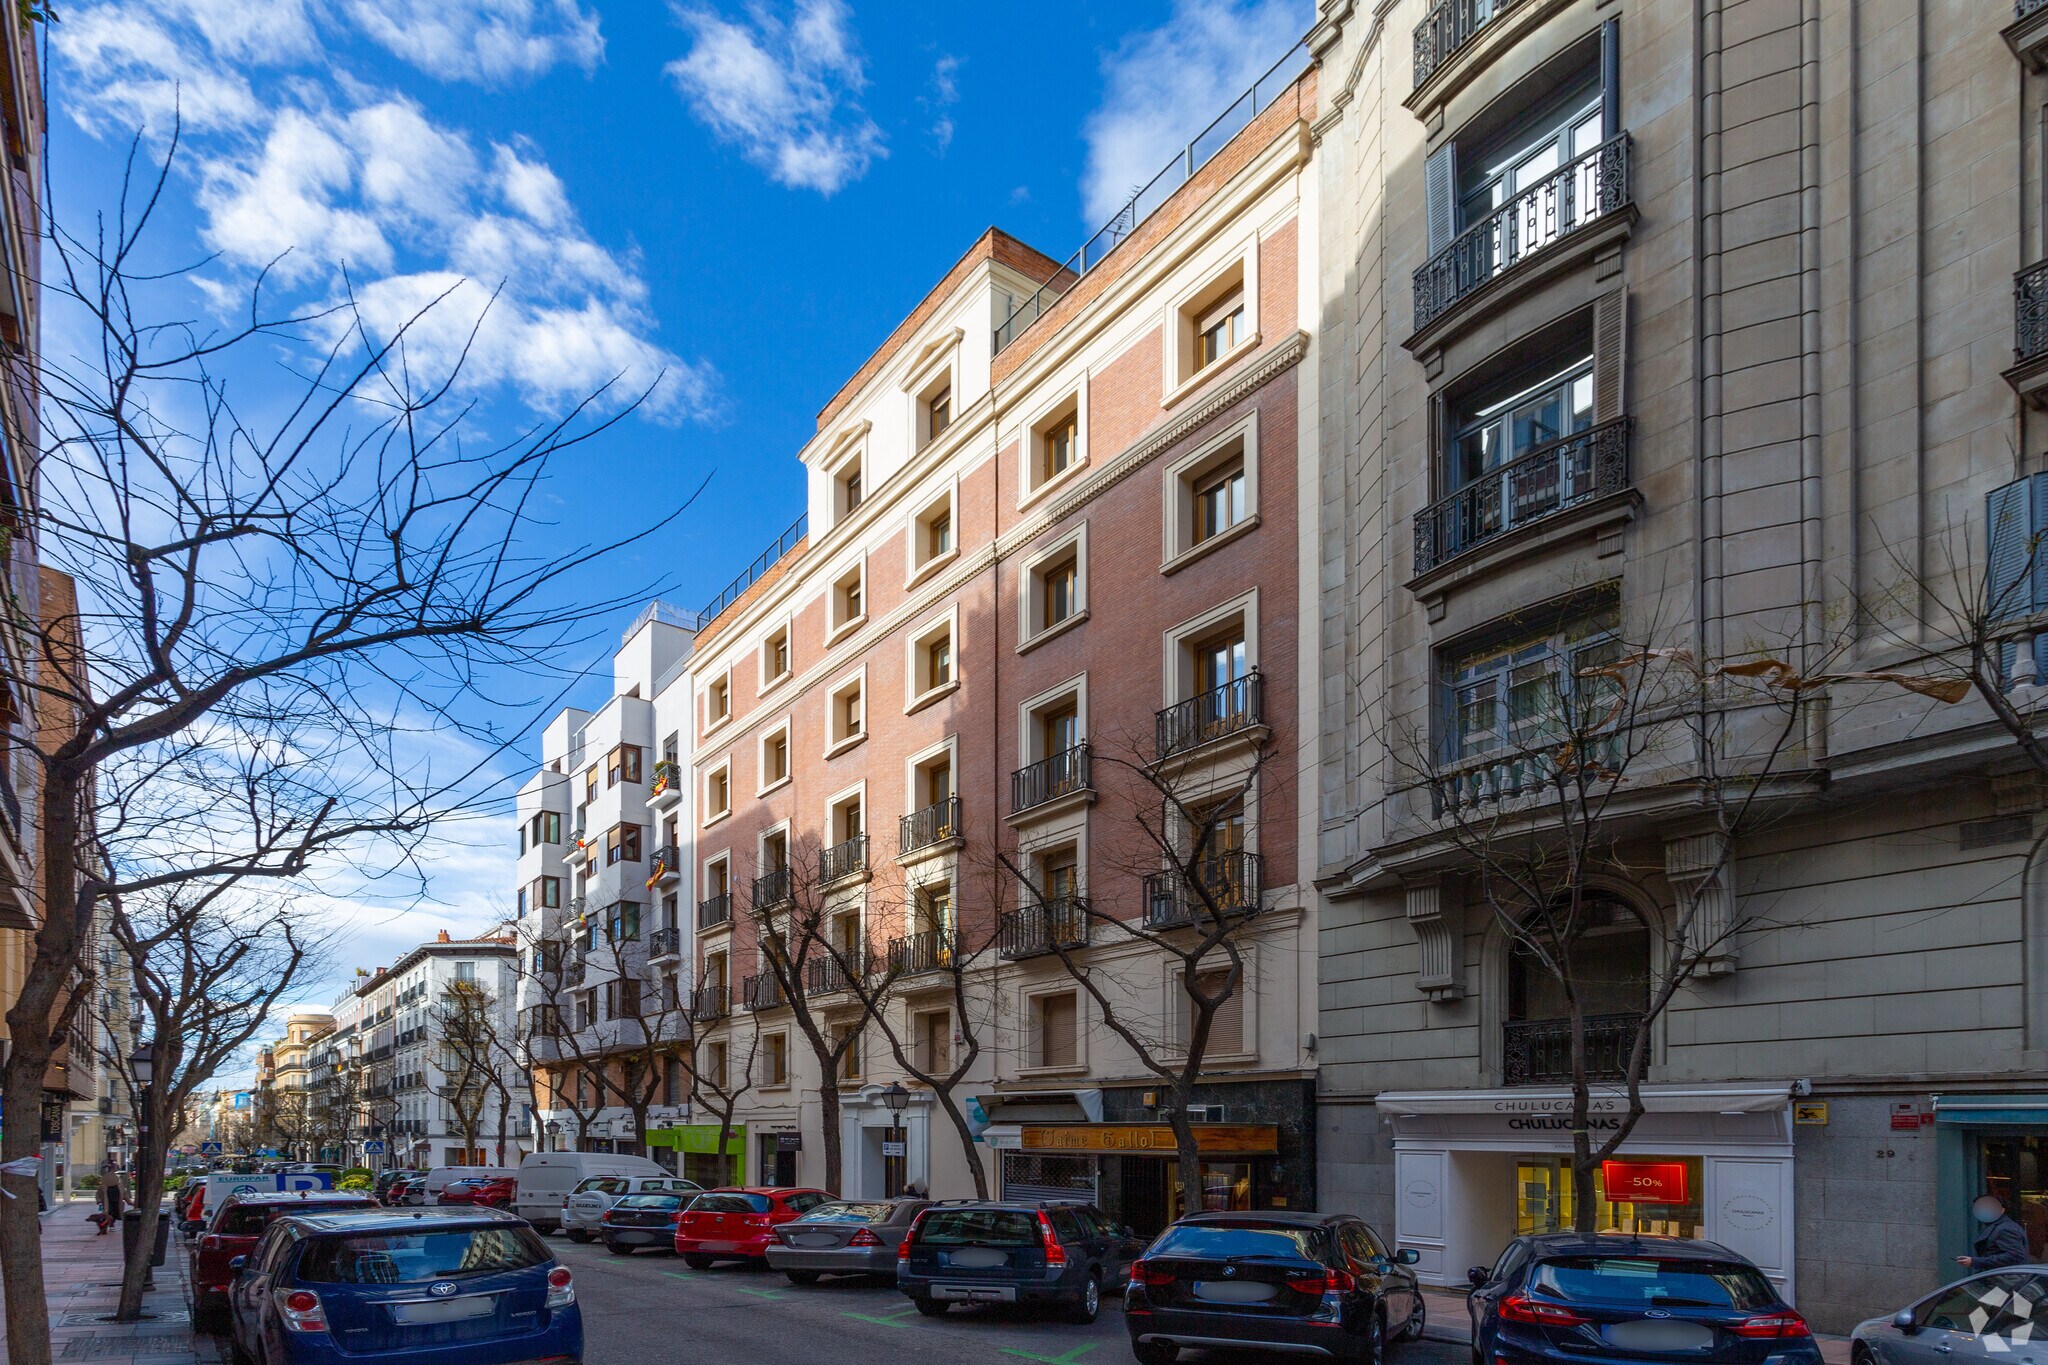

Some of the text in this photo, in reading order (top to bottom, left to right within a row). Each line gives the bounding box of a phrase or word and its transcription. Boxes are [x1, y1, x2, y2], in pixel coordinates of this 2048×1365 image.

[1494, 1100, 1615, 1111] CHULUCAAS
[1508, 1118, 1620, 1130] CHULUCNAS
[1876, 1149, 1896, 1159] 29
